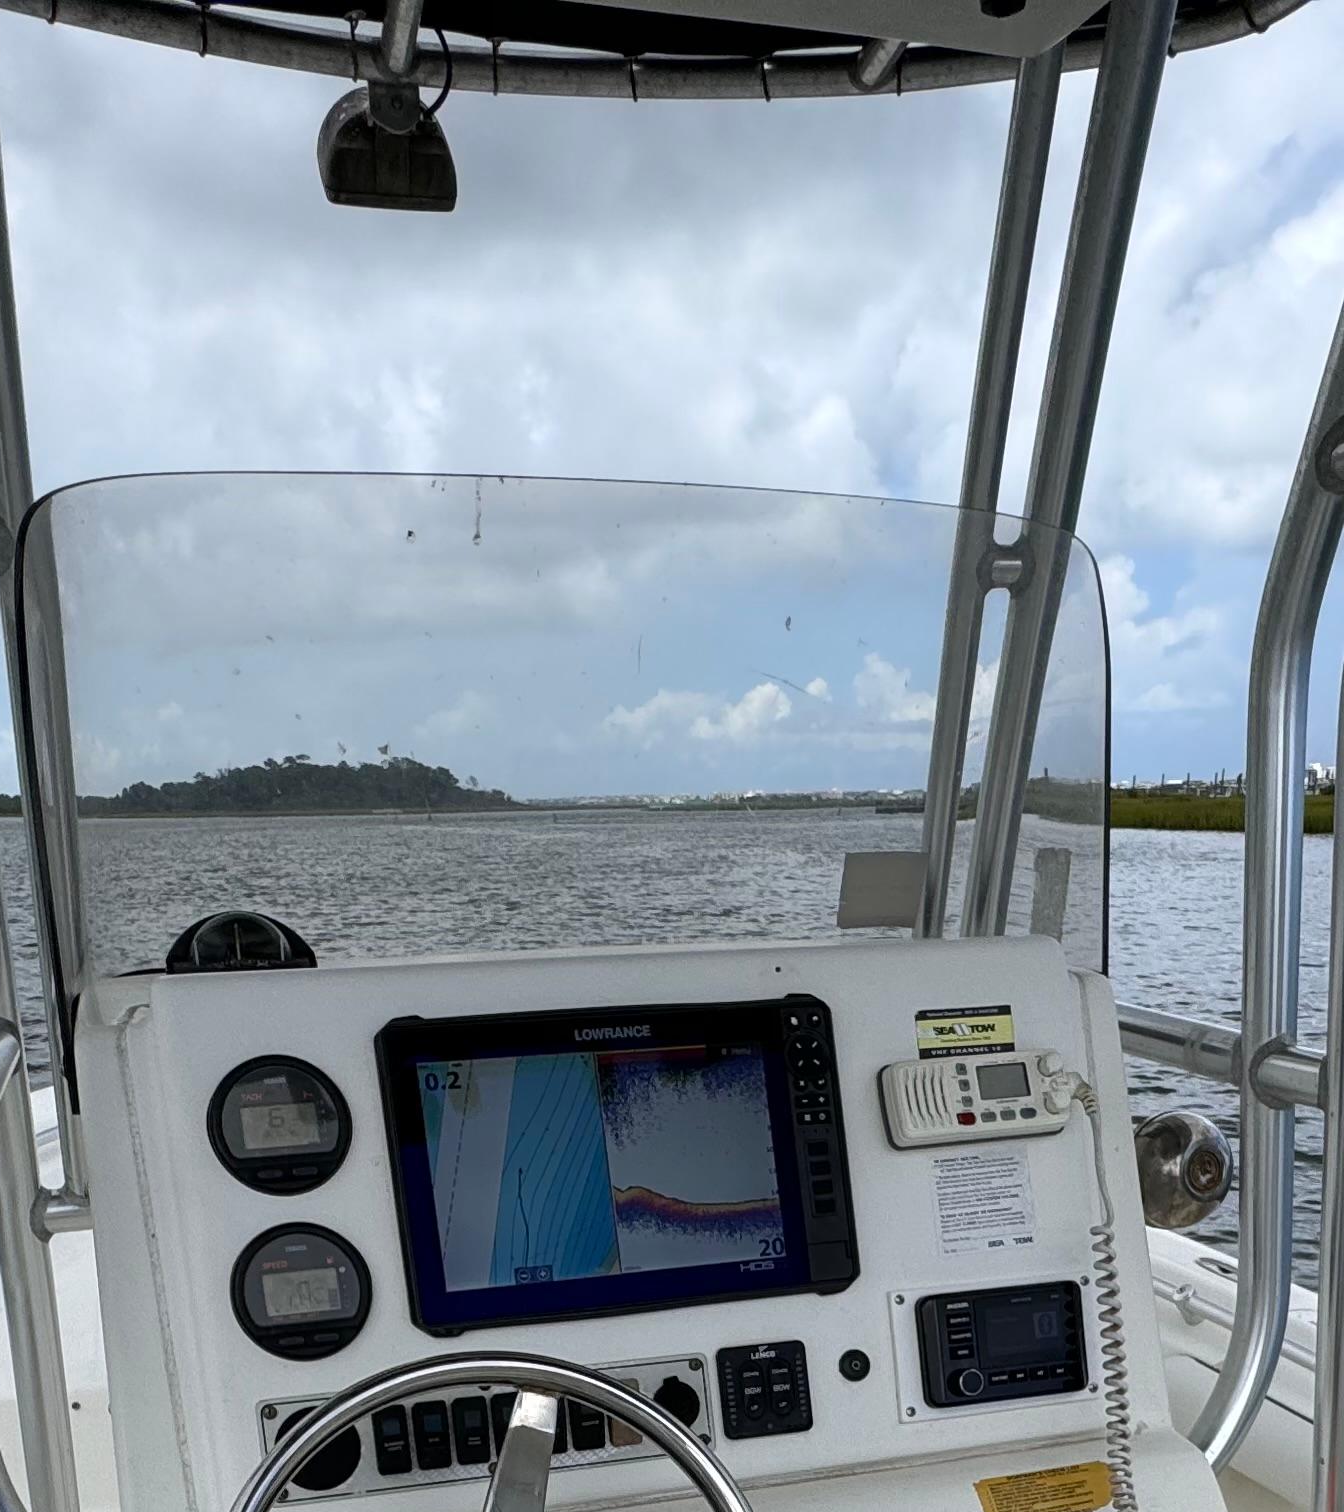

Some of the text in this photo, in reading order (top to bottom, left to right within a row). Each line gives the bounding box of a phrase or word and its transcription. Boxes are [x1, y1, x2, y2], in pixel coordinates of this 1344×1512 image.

[574, 1024, 652, 1041] LOWRANCE
[932, 1023, 996, 1036] SEA TOW
[424, 1070, 462, 1091] 0.2
[758, 1237, 785, 1257] 20
